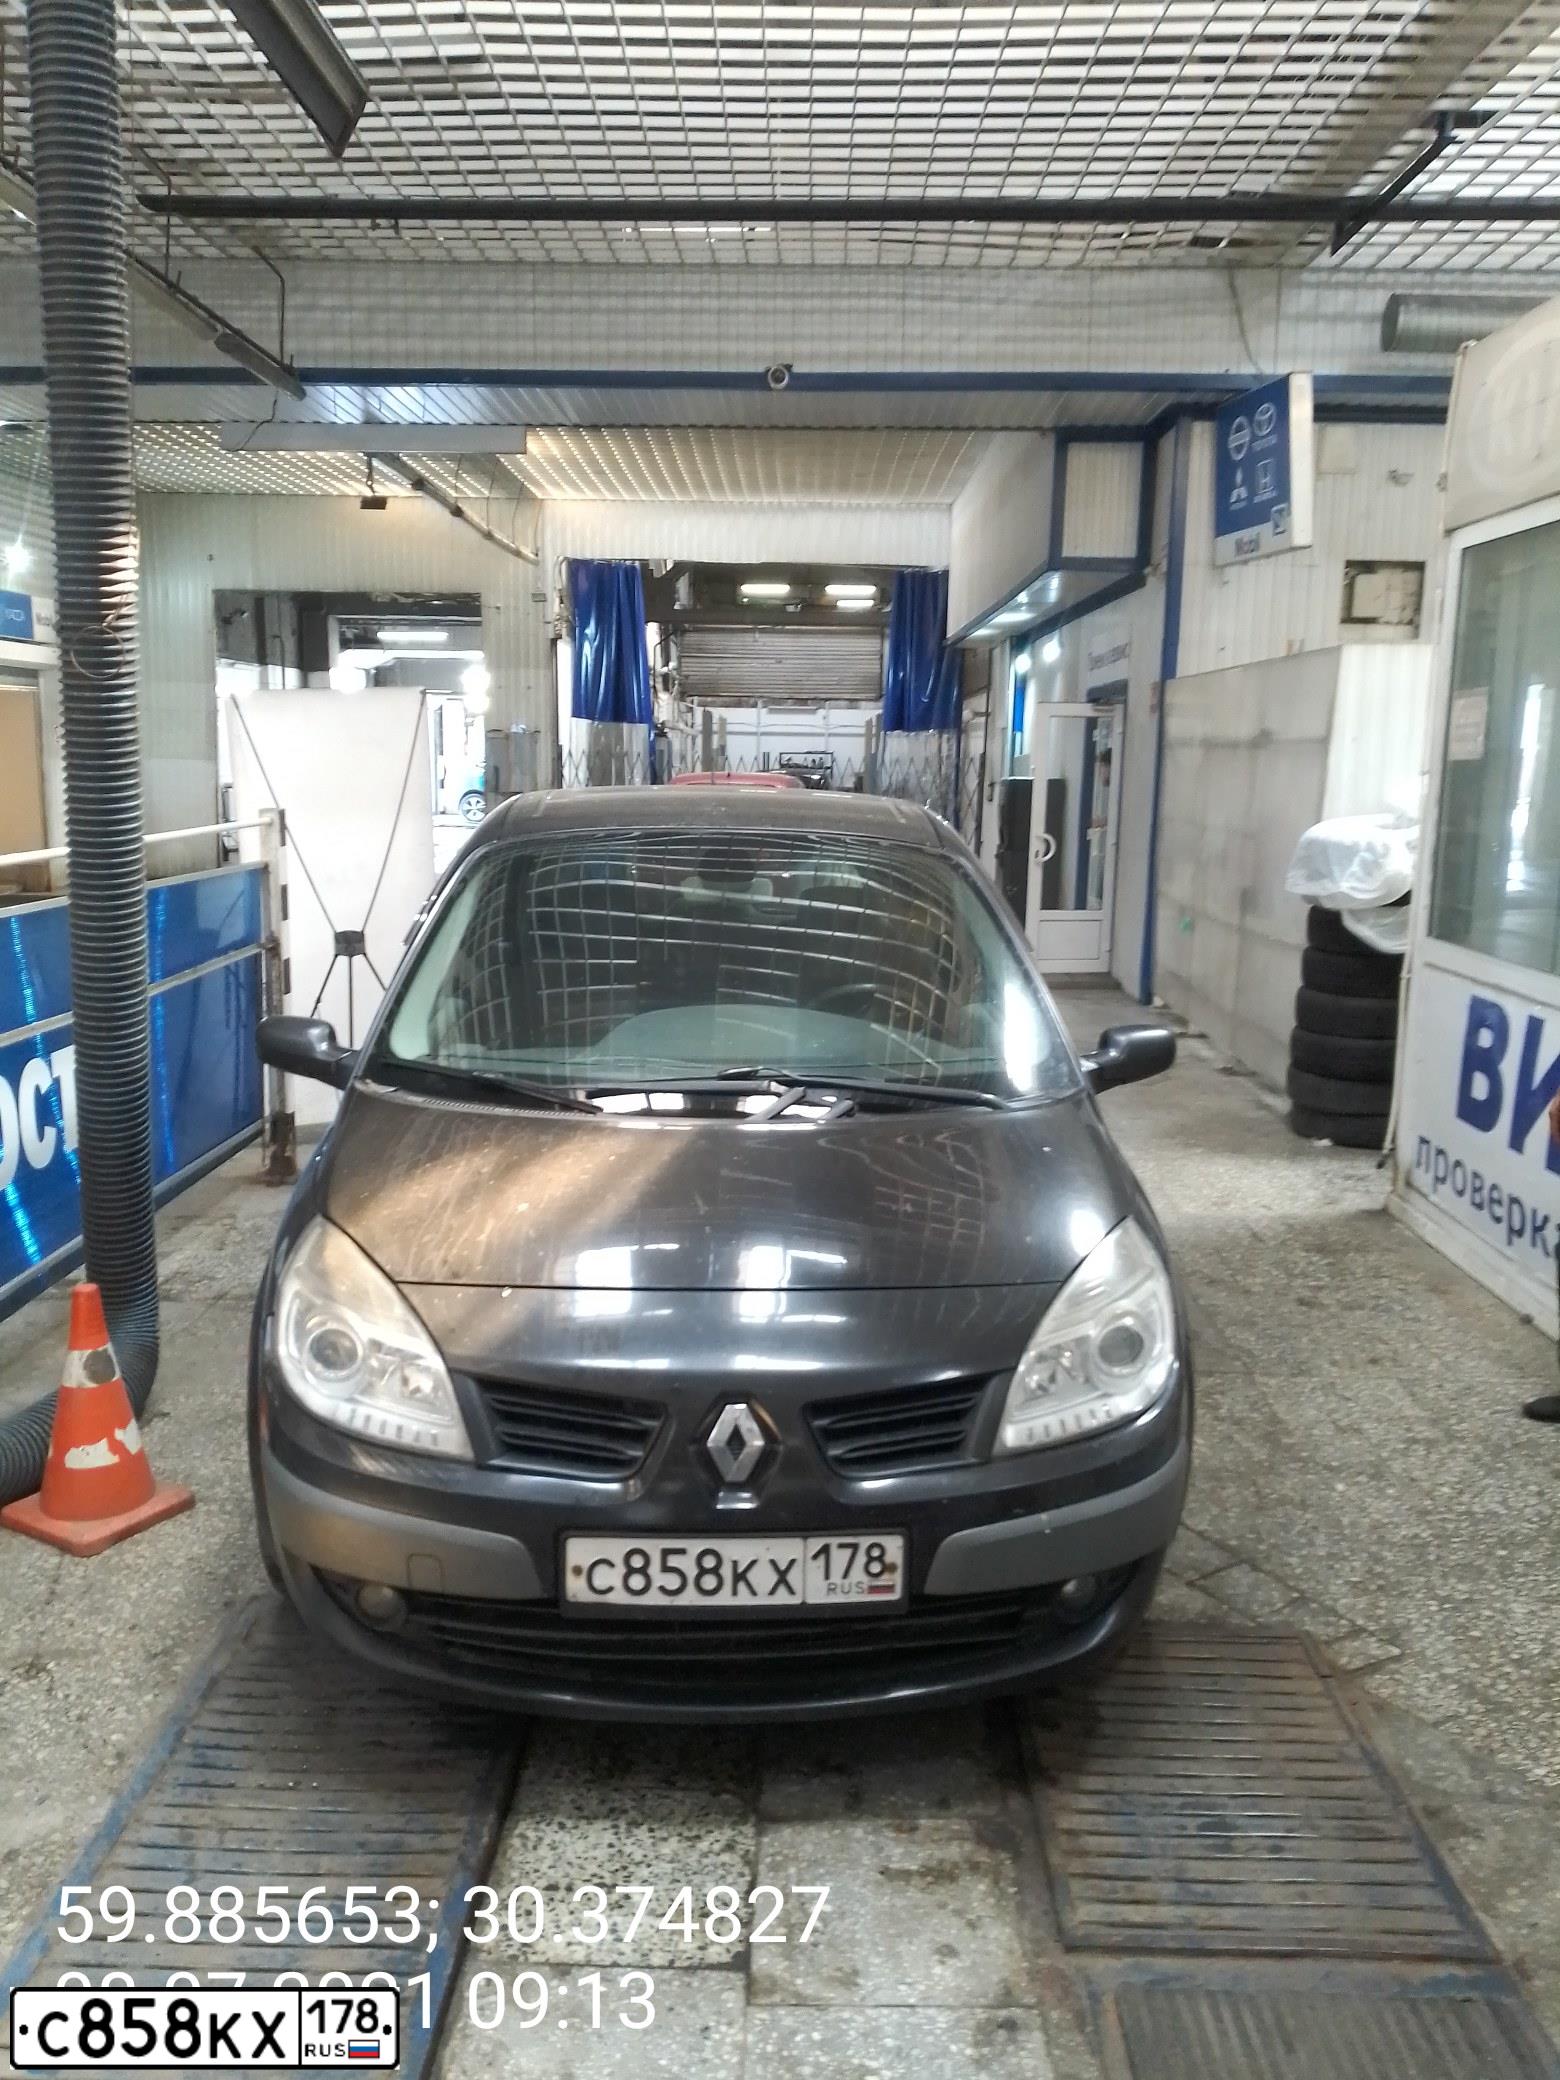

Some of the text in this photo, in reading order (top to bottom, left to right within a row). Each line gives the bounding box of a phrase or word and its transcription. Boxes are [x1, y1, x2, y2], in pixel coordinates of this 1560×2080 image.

[1415, 1135, 1560, 1257] проверк
[586, 1542, 886, 1596] С858КХ 178
[826, 1581, 865, 1596] RUS
